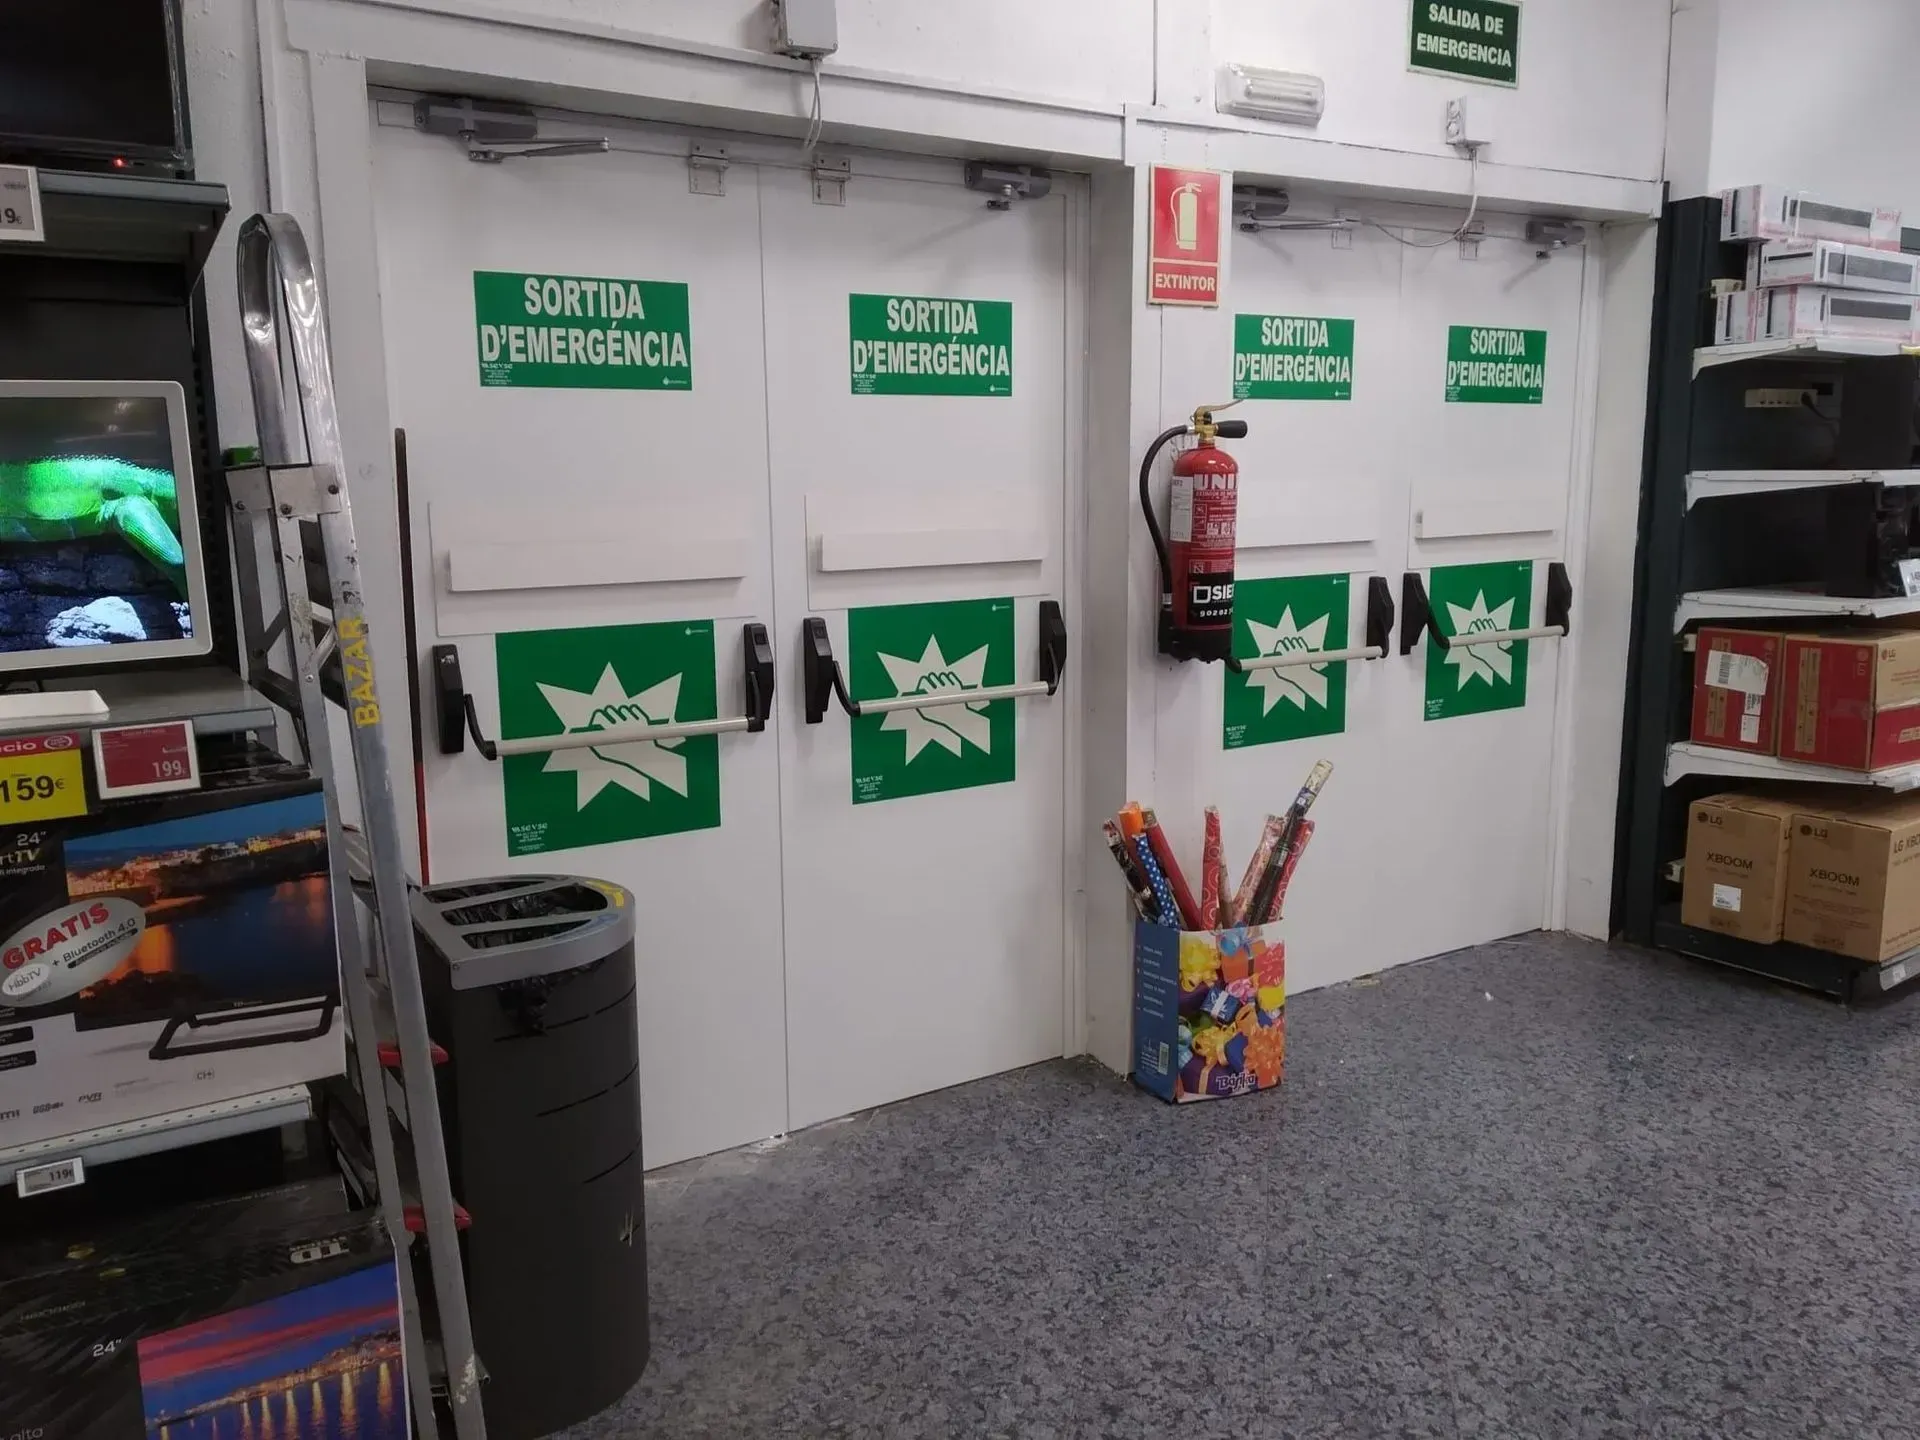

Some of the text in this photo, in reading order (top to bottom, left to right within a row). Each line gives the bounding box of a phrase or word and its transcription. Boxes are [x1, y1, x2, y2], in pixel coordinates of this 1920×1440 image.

[1429, 3, 1504, 35] SALIDA DE
[1416, 32, 1512, 68] EMERGENCIA
[1155, 272, 1216, 292] EXTINTOR
[524, 277, 645, 320] SORTIDA
[886, 298, 978, 335] SORTIDA
[481, 320, 688, 368] D'EMERGÉNCIA
[1261, 317, 1329, 348] SORTIDA
[1469, 329, 1526, 356] SORTIDA
[853, 336, 1010, 376] D'EMERGÉNCIA
[1235, 349, 1350, 383] D'EMERGÉNCIA
[1447, 357, 1543, 388] D'EMERGÉNCIA
[339, 616, 381, 727] BAZAR
[0, 741, 37, 754] cio
[1709, 814, 1723, 827] LG
[1814, 828, 1829, 839] LG
[1707, 850, 1754, 870] XBOOM
[1893, 840, 1904, 854] LG
[1809, 867, 1861, 888] XBOOM
[2, 902, 109, 970] GRATIS
[62, 928, 117, 963] Bluetooth
[117, 917, 137, 935] 4.0
[8, 967, 42, 992] HbbTV
[92, 1338, 122, 1357] 24"
